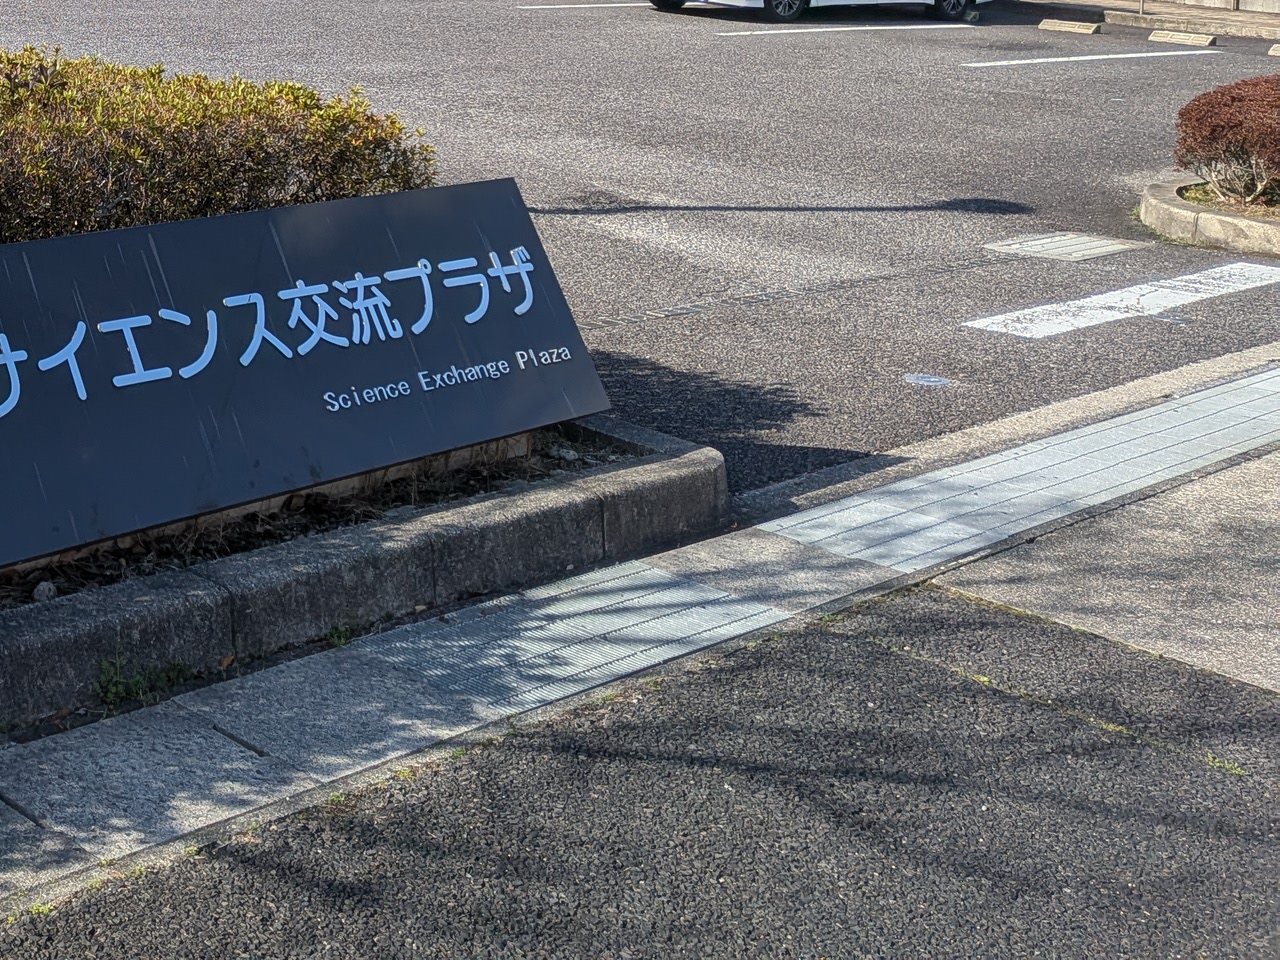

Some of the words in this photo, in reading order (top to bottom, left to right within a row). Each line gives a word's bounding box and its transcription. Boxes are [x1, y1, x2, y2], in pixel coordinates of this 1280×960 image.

[323, 381, 411, 412] Science
[417, 360, 510, 391] Exchange
[515, 346, 572, 370] Plaza
